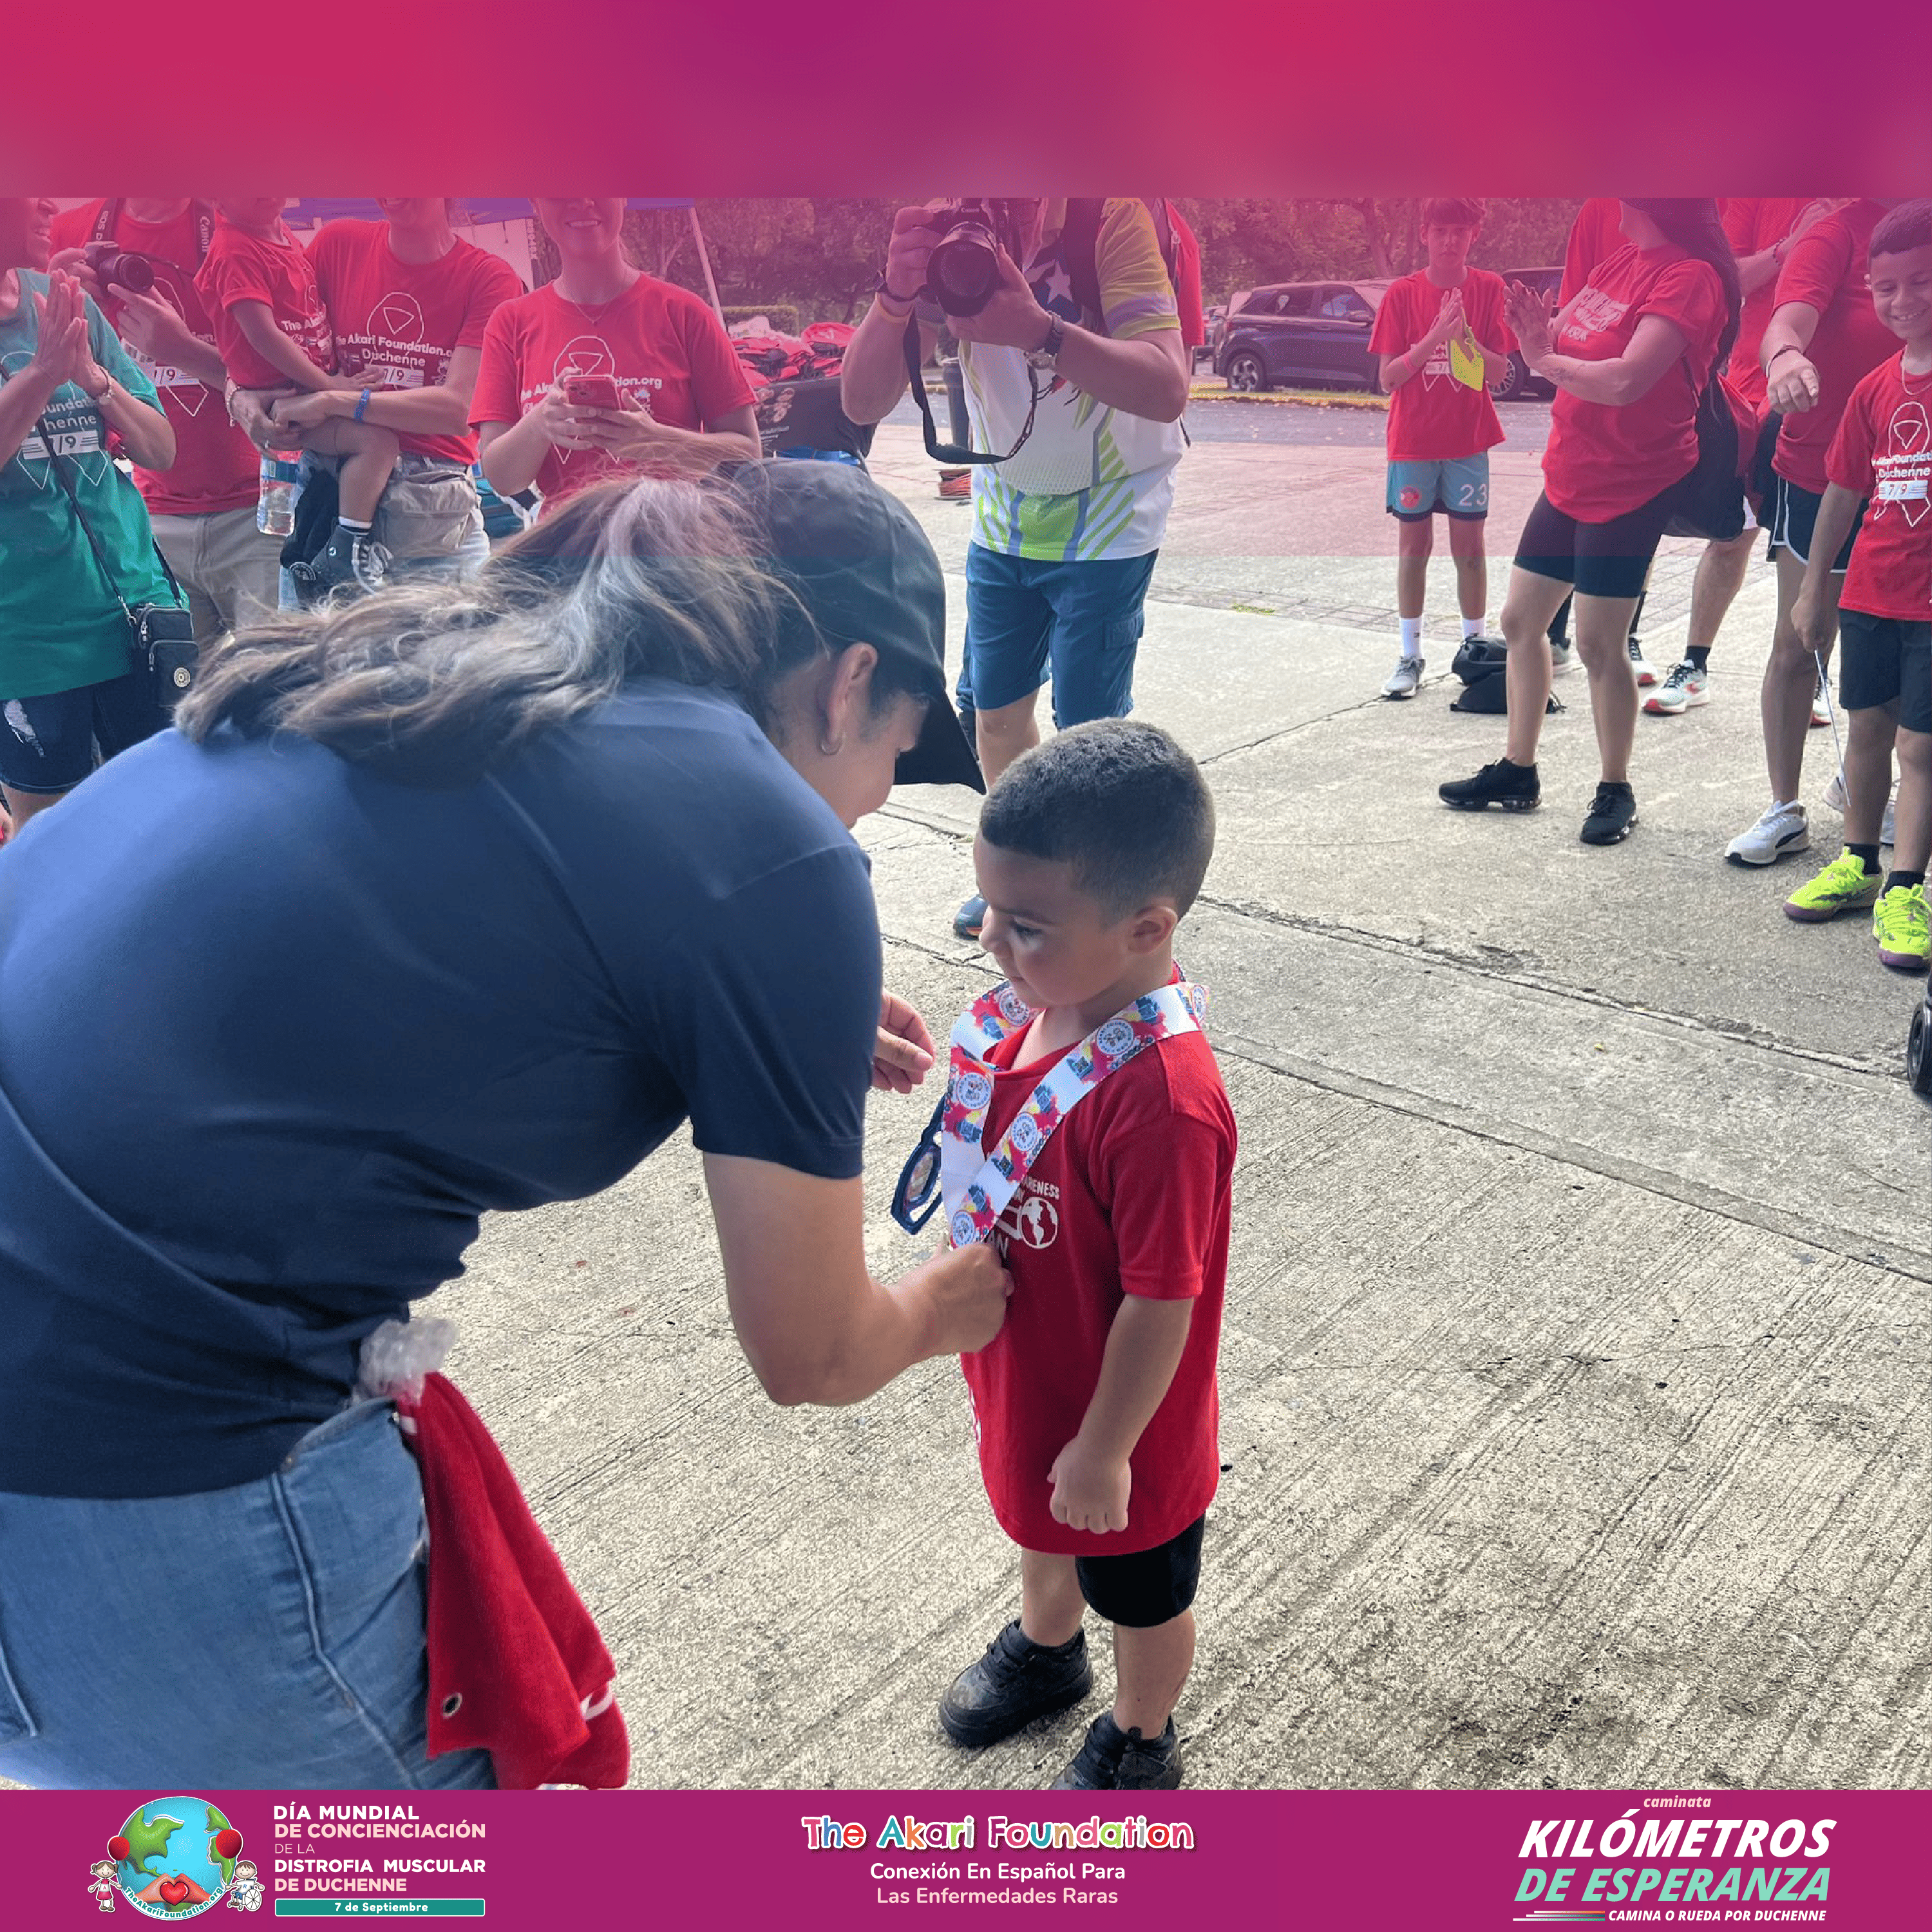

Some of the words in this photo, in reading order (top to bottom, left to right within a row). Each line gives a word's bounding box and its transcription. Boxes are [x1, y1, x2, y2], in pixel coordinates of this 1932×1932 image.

[200, 216, 211, 253] Canon
[348, 332, 375, 345] Akari
[378, 336, 452, 357] Foundation.o
[361, 348, 426, 366] Duchenne
[43, 415, 97, 432] henne
[1879, 466, 1931, 478] Duchenne
[1458, 484, 1488, 506] 23
[1888, 484, 1908, 497] 7/9
